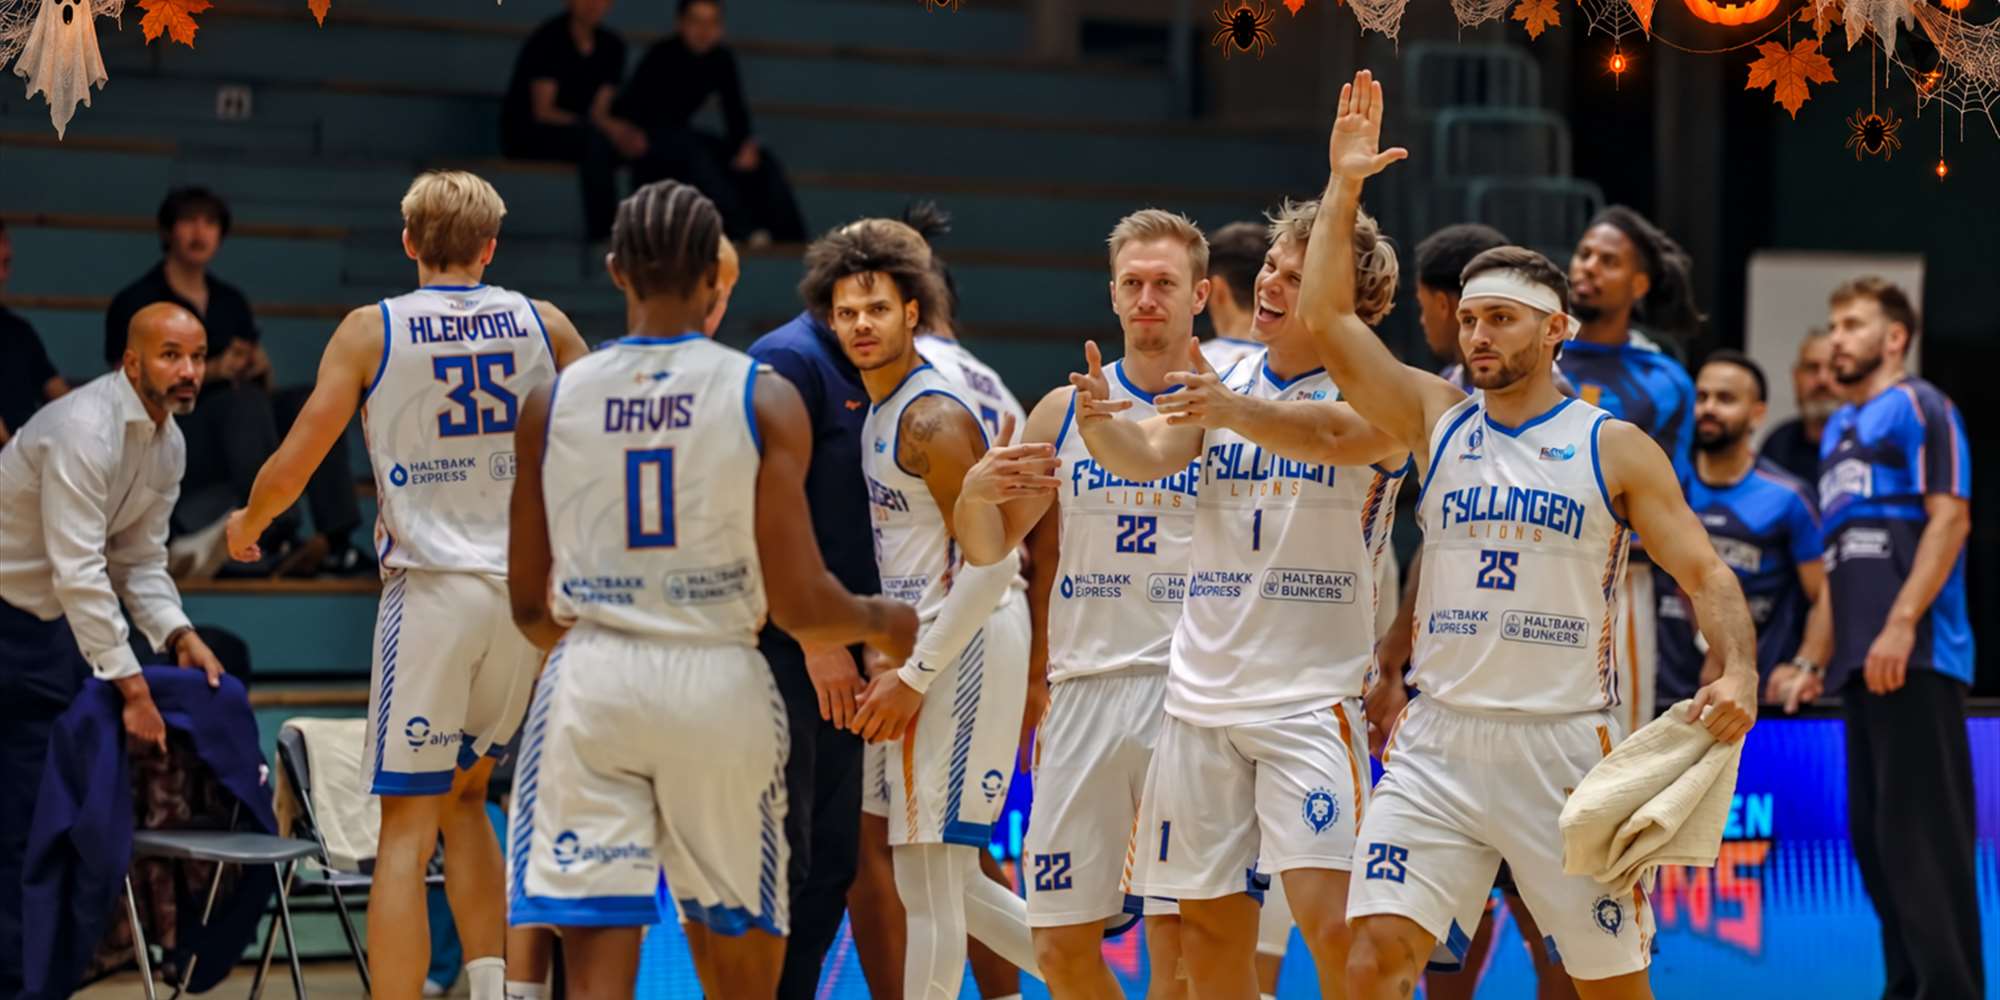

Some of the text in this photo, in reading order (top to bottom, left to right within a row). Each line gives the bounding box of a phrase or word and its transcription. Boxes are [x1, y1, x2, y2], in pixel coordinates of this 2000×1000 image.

[409, 311, 528, 344] HLEIVDAL
[431, 352, 519, 439] 35
[604, 394, 695, 433] DAVIS
[410, 457, 476, 473] HALTBAKK
[412, 470, 467, 485] EXPRESS
[1231, 481, 1299, 497] LIONS
[624, 446, 677, 551] 0
[1106, 491, 1182, 508] LIONS
[1442, 486, 1585, 540] FYLLINGEN
[1116, 514, 1157, 554] 22
[1252, 509, 1263, 551] 1
[1469, 523, 1543, 543] LIONS
[1075, 573, 1132, 585] HALTBAKK
[1198, 572, 1253, 584] HALTBAKK
[1282, 572, 1353, 587] HALTBAKK
[1476, 549, 1520, 592] 25
[1075, 586, 1122, 598] EXPRESS
[1281, 585, 1342, 599] BUNKERS
[1436, 610, 1489, 622] HALTBAKK
[1524, 615, 1585, 632] HALTBAKK
[1522, 627, 1579, 644] BUNKERS
[1158, 820, 1171, 862] 1
[1035, 851, 1073, 892] 22
[1365, 842, 1408, 884] 25
